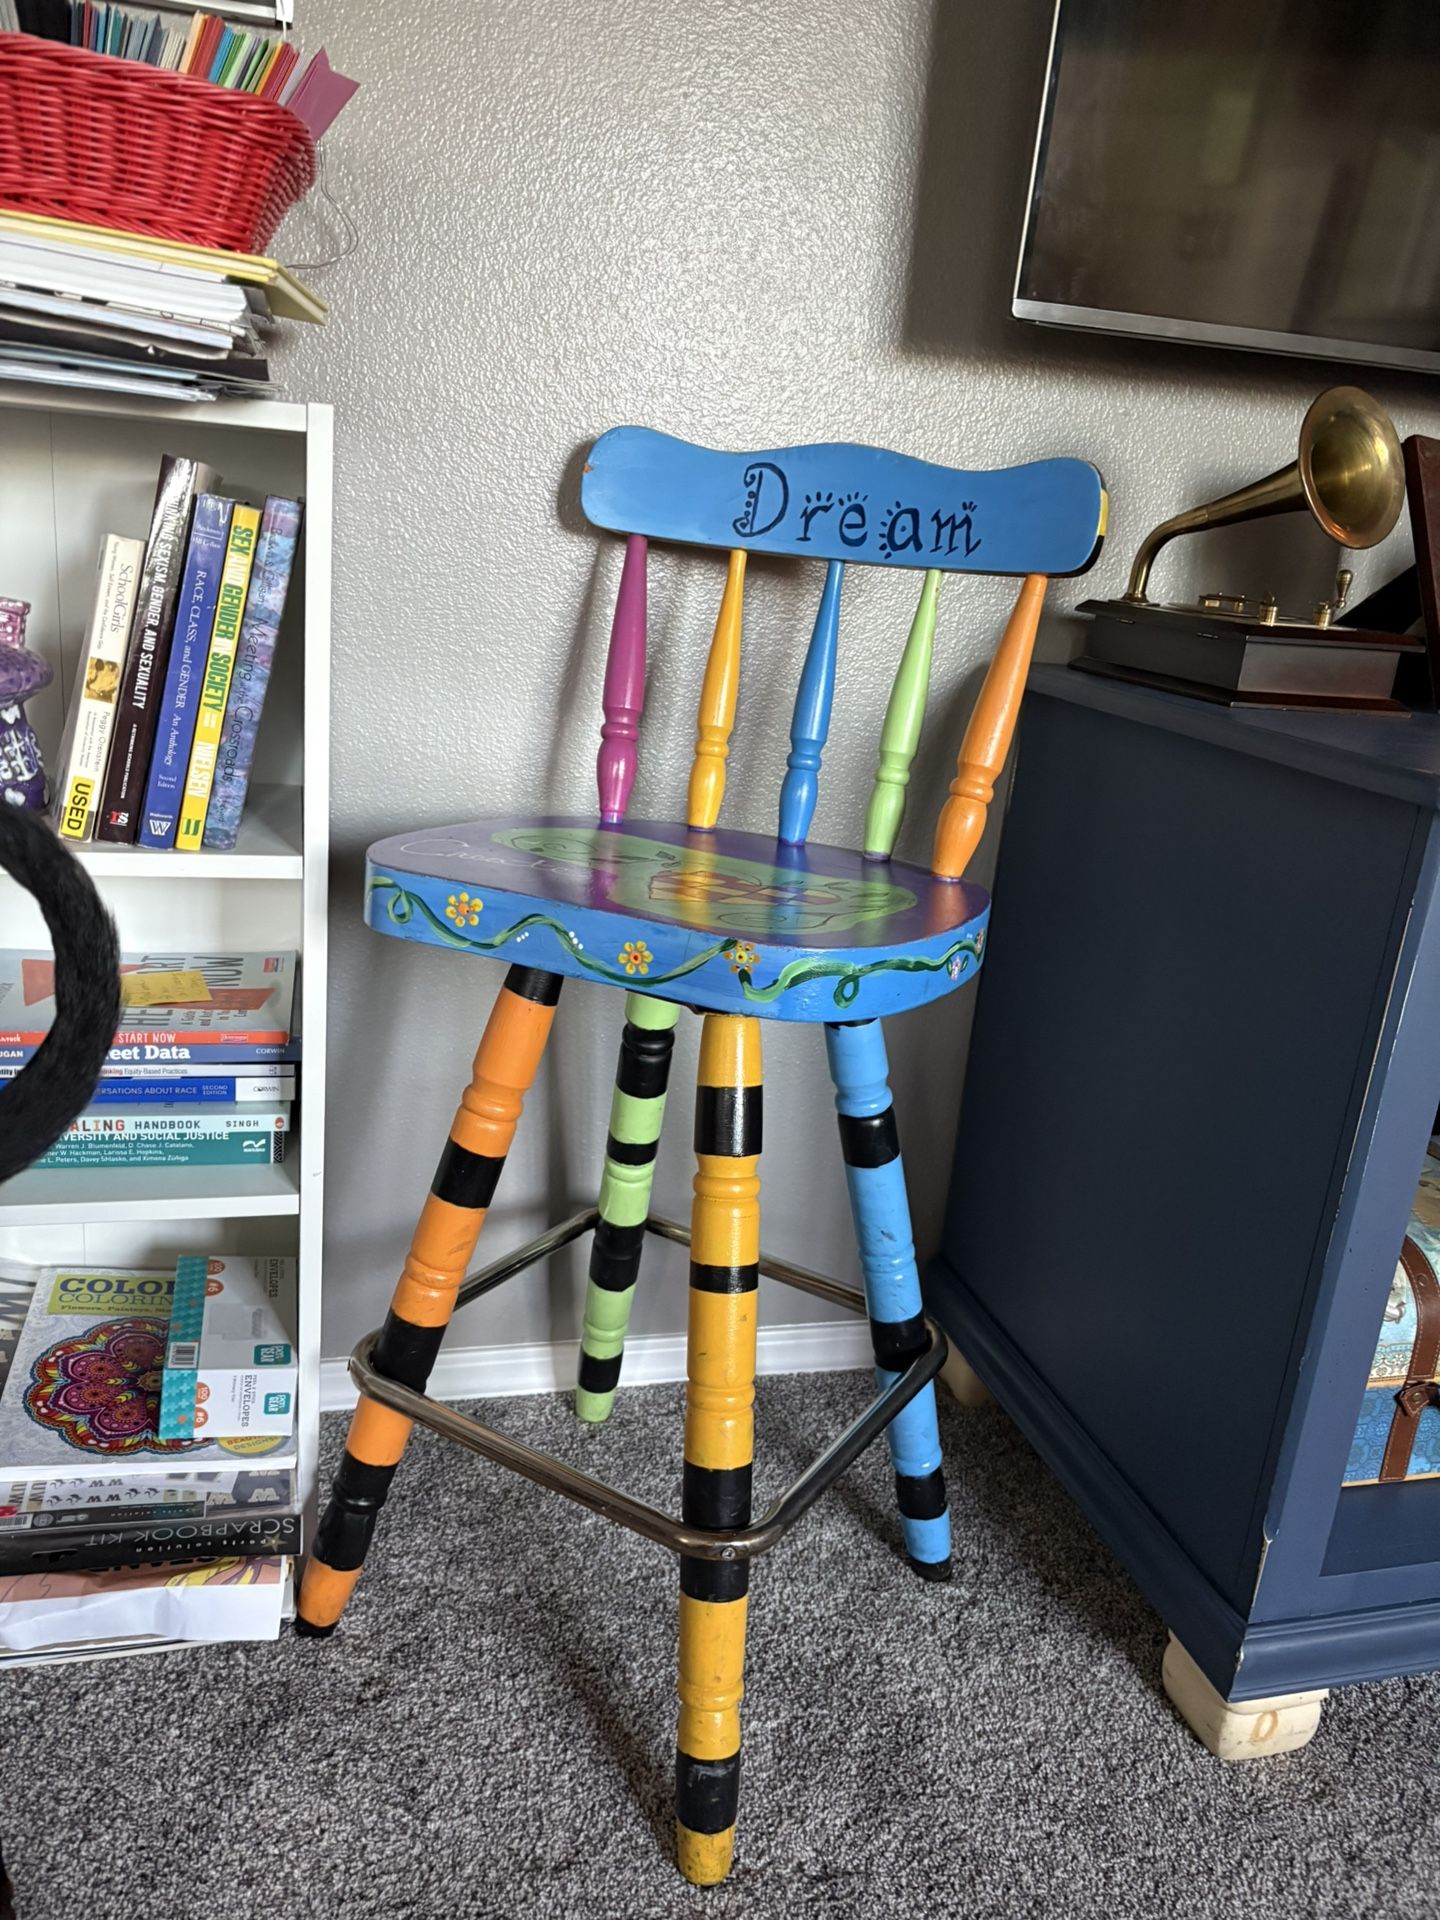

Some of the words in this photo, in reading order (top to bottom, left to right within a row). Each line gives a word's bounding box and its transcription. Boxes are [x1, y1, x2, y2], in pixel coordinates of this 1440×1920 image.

[733, 462, 982, 559] Dream
[229, 525, 253, 556] SEX
[110, 562, 133, 633] SchoolGirls
[192, 570, 207, 604] RACE,
[143, 585, 165, 628] GENDER,
[184, 605, 201, 643] CLASS,
[215, 583, 244, 640] GENDER
[142, 628, 158, 651] AND
[182, 645, 193, 663] and
[238, 616, 269, 682] Meeting
[132, 652, 154, 709] SEXUALITY
[175, 664, 191, 709] GENDER
[203, 652, 232, 712] SOCIETY
[172, 714, 182, 727] An
[163, 728, 180, 766] Anthology
[221, 705, 254, 783] Crossroads
[187, 740, 216, 798] NIELSEN
[66, 782, 91, 831] USED
[400, 837, 570, 875] Create
[0, 1050, 24, 1058] UGAN
[105, 1045, 141, 1061] eet
[144, 1044, 191, 1060] Data
[118, 1032, 148, 1044] START
[152, 1032, 176, 1043] NOW
[255, 1047, 285, 1055] CORWIN
[101, 1086, 143, 1095] RSATIONS
[145, 1086, 173, 1095] ABOUT
[175, 1086, 197, 1094] RACE
[62, 1132, 110, 1141] VERSITY
[113, 1132, 138, 1141] AND
[140, 1131, 181, 1141] SOCIAL
[183, 1131, 230, 1140] JUSTICE
[69, 1119, 126, 1132] ALING
[134, 1119, 201, 1130] HANDBOOK
[225, 1119, 259, 1128] SINGH
[268, 1258, 280, 1298] ENVELOPES
[58, 1293, 172, 1306] COLORIN
[241, 1374, 253, 1428] ENVELOPES
[85, 1531, 123, 1547] KIT
[134, 1517, 296, 1542] SCRAPBOOK
[135, 1541, 213, 1553] solution
